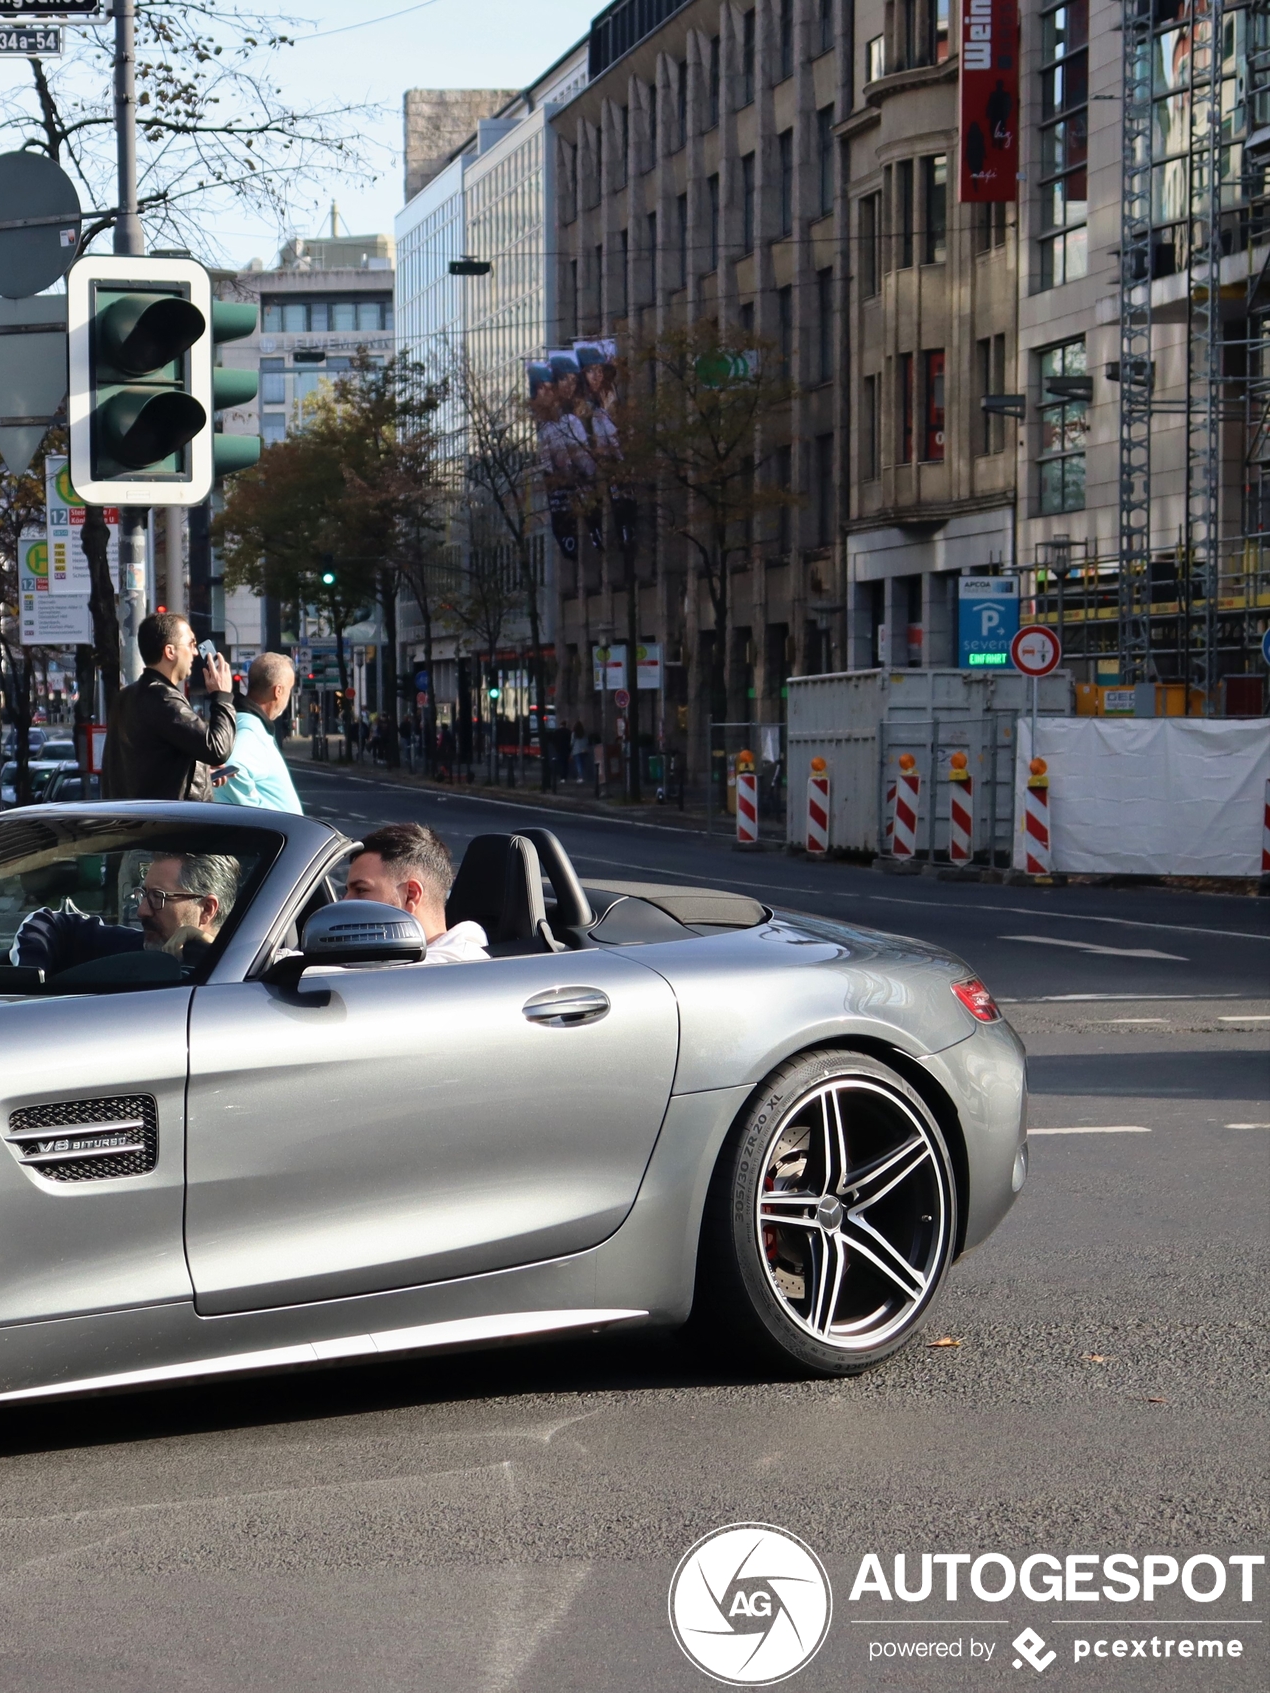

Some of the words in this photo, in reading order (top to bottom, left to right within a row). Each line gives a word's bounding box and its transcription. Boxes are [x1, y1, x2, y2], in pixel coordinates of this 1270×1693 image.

[51, 511, 67, 524] 12
[22, 580, 34, 590] 12
[963, 640, 1011, 650] seven
[969, 653, 1007, 666] EINFAHRT
[37, 1139, 69, 1153] V8
[72, 1137, 127, 1150] BITURBO
[735, 1160, 750, 1223] 305/30
[743, 1136, 758, 1159] ZR
[753, 1114, 768, 1136] 20
[766, 1093, 784, 1111] XL
